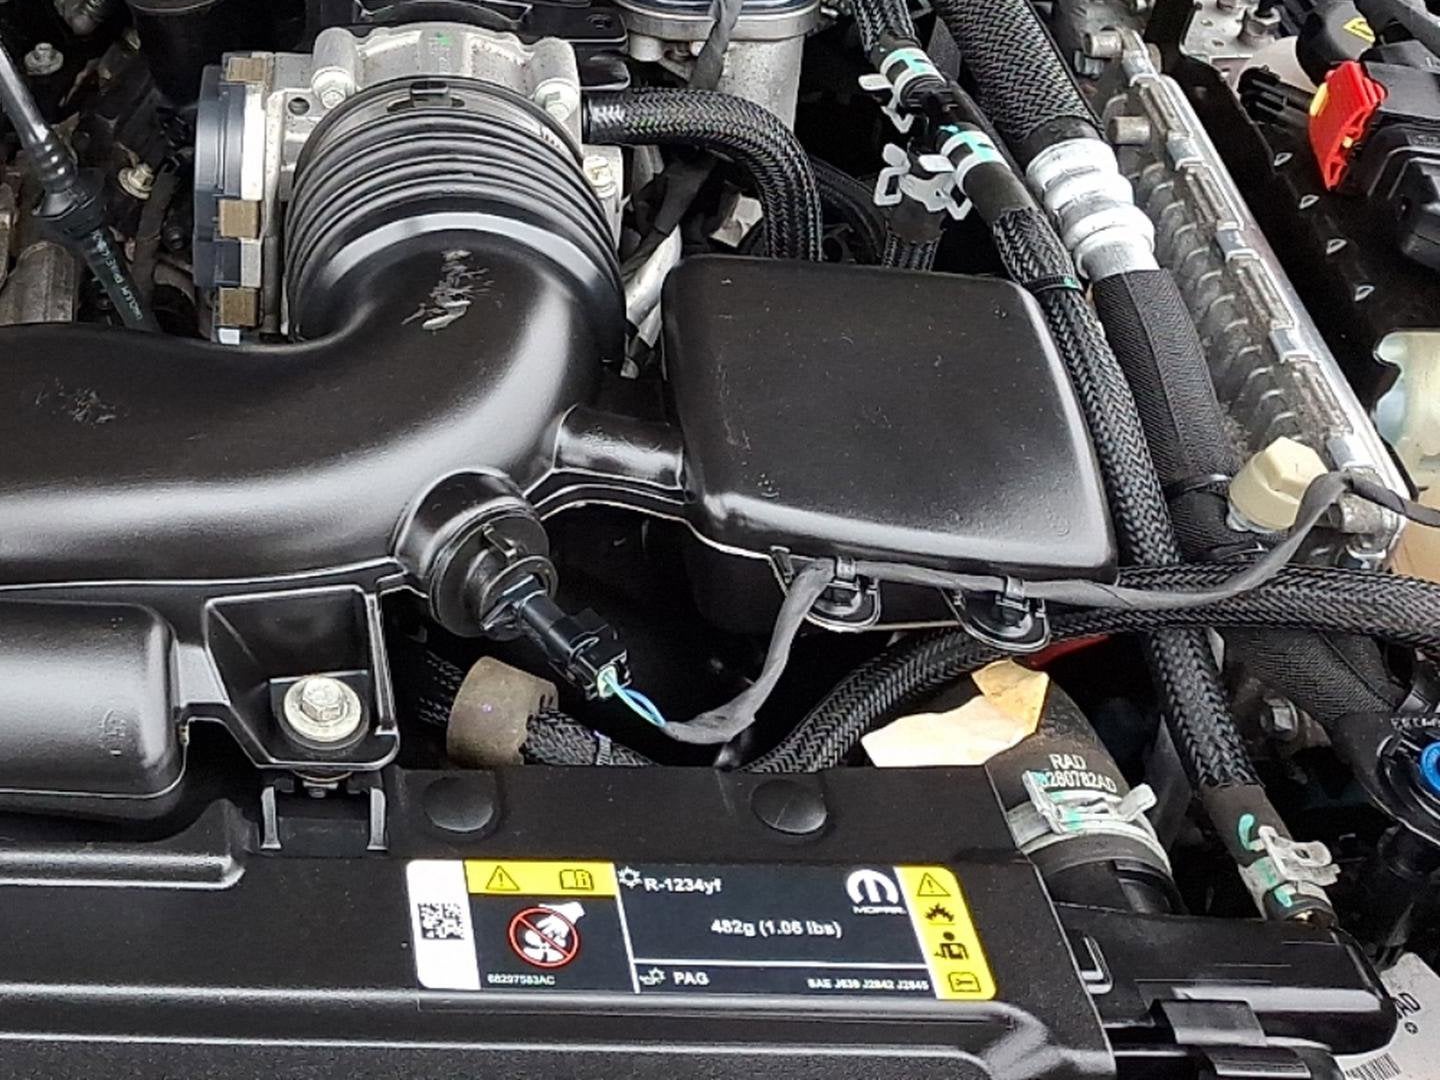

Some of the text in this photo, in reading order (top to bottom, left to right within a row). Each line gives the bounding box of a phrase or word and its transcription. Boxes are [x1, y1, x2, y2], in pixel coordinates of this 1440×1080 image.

[1049, 753, 1087, 770] RAD
[1034, 770, 1118, 793] 8280782AD
[643, 877, 722, 895] R-1234yf
[710, 919, 756, 937] 482g
[805, 920, 842, 938] lbs)
[673, 971, 710, 986] PAG
